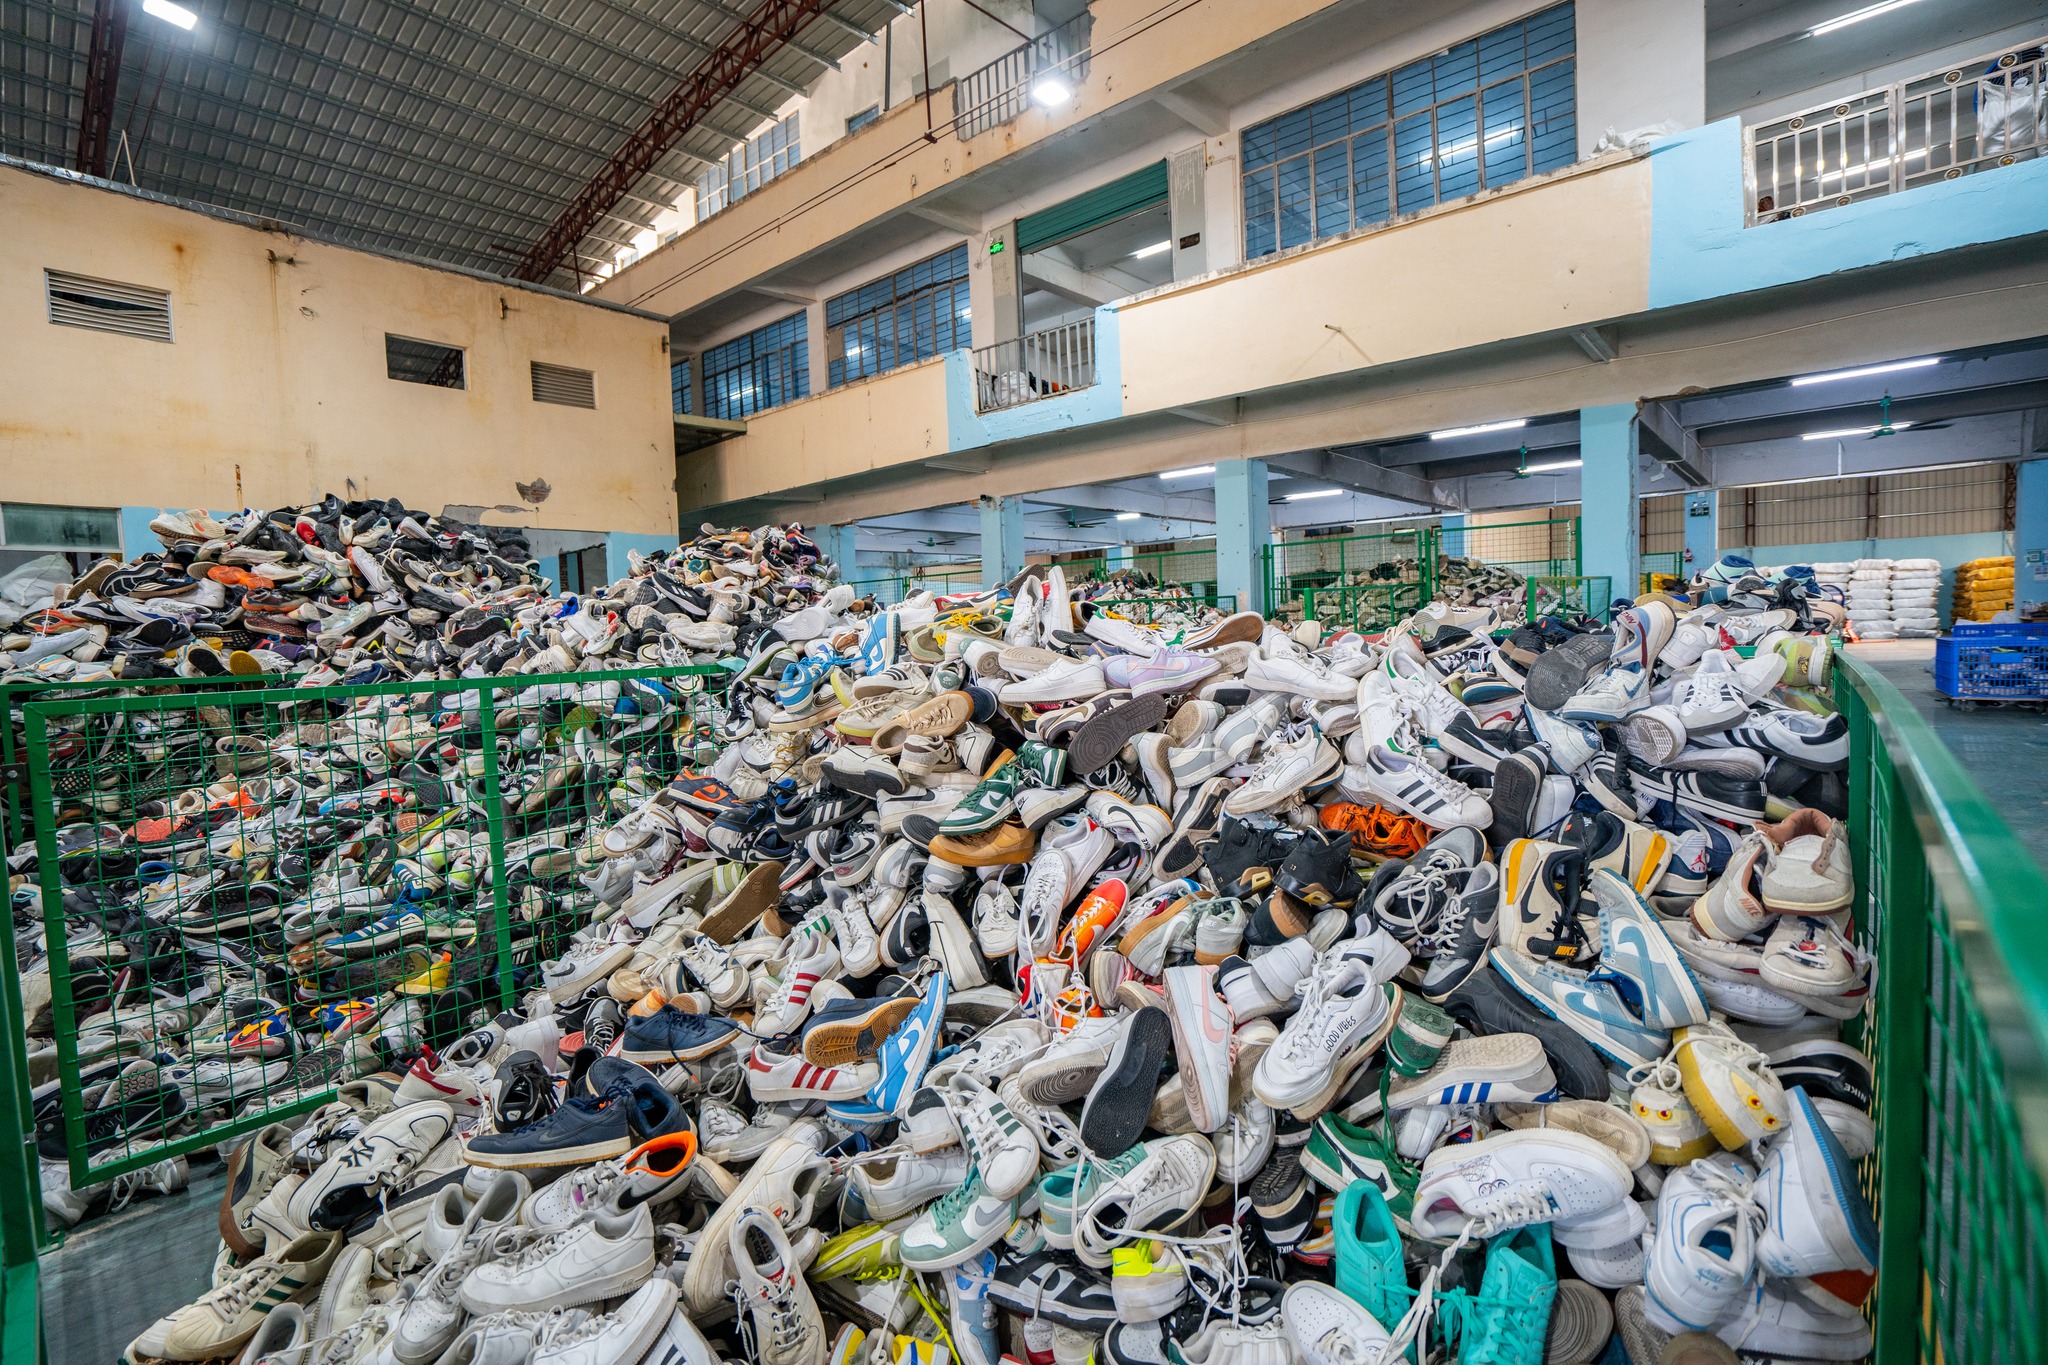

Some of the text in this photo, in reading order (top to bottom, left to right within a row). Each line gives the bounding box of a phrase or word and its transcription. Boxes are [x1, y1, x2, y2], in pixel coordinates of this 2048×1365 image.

[1620, 611, 1637, 624] NIKE
[1639, 792, 1654, 805] NIKE
[1739, 897, 1762, 917] NIKE
[1378, 919, 1396, 931] NIKE
[1554, 945, 1578, 957] NIKE
[1324, 1015, 1357, 1053] GOOD VIBES
[1842, 1082, 1866, 1103] NIKE
[1012, 1225, 1028, 1243] NIKE
[1277, 1244, 1294, 1254] NIKE
